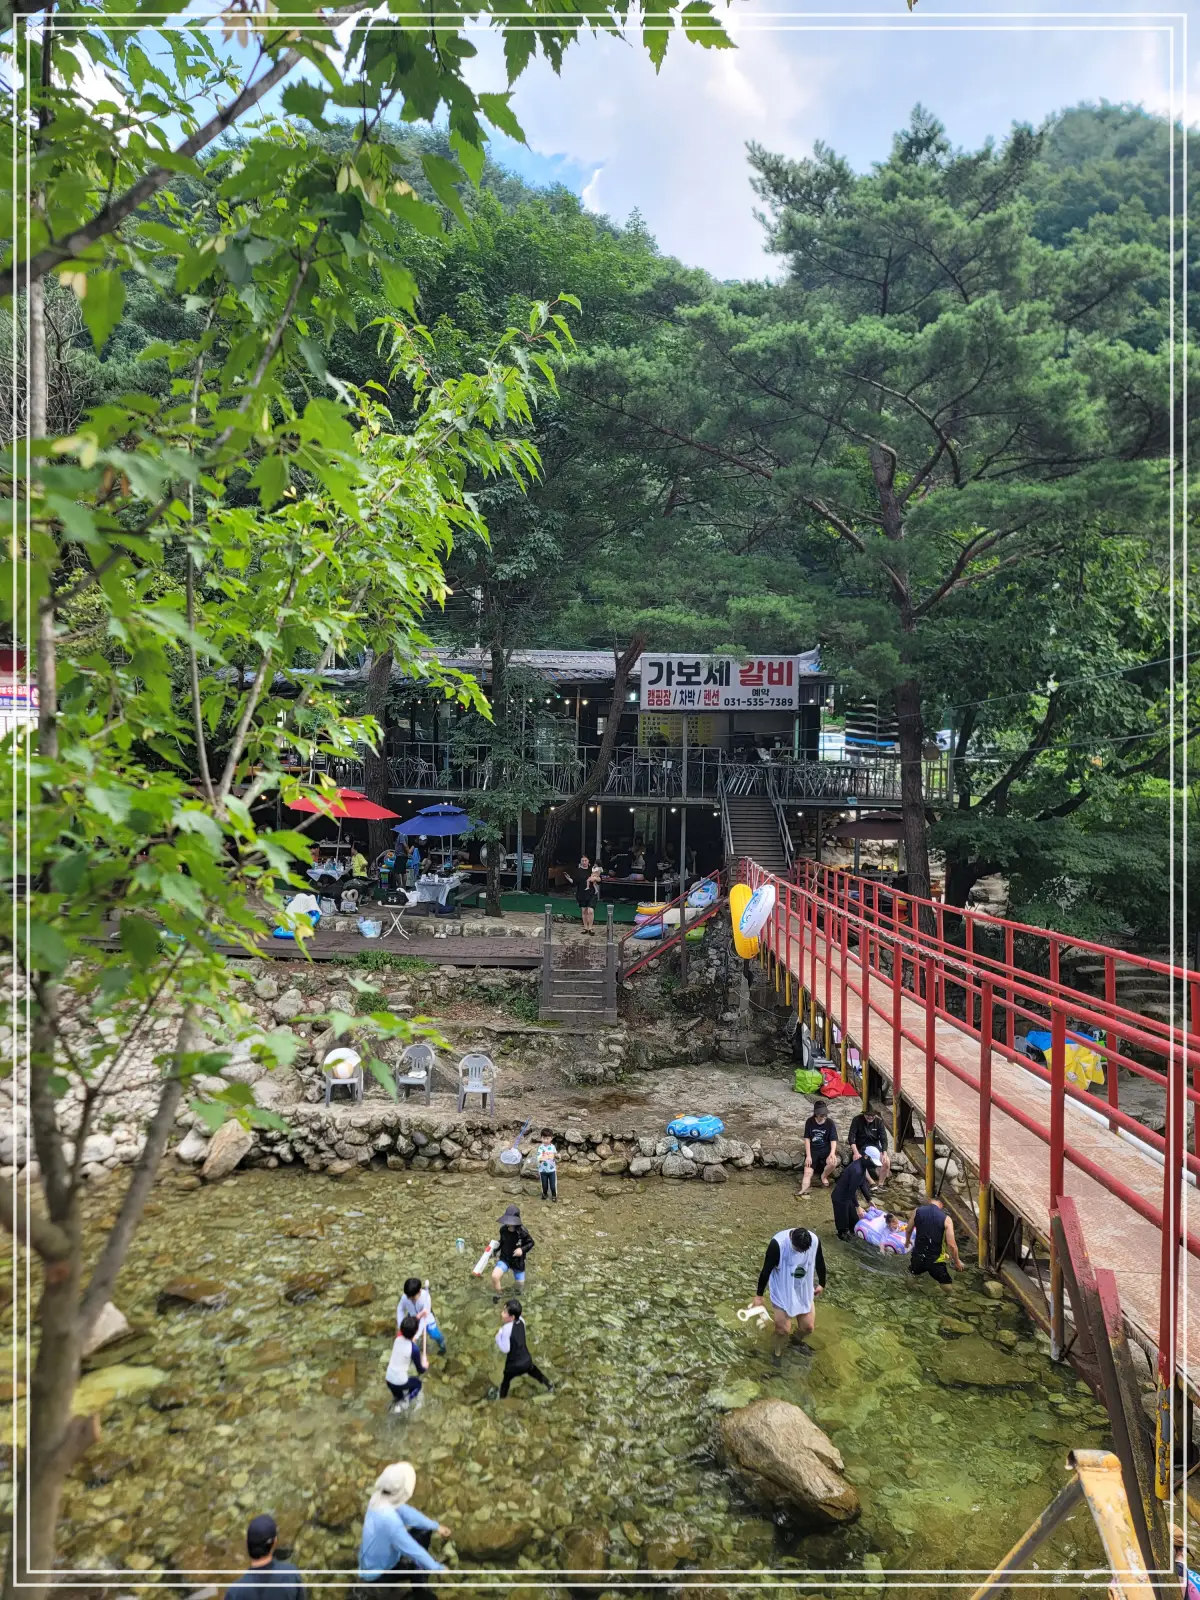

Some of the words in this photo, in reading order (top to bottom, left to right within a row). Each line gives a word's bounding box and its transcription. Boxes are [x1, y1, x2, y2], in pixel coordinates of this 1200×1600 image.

[648, 660, 731, 686] 가보세
[739, 660, 793, 686] 갈비
[647, 689, 671, 706] 캠핑장
[679, 689, 695, 706] 차박
[704, 689, 720, 706] 펜션
[752, 688, 770, 697] 예약
[724, 698, 793, 707] 031-535-7389
